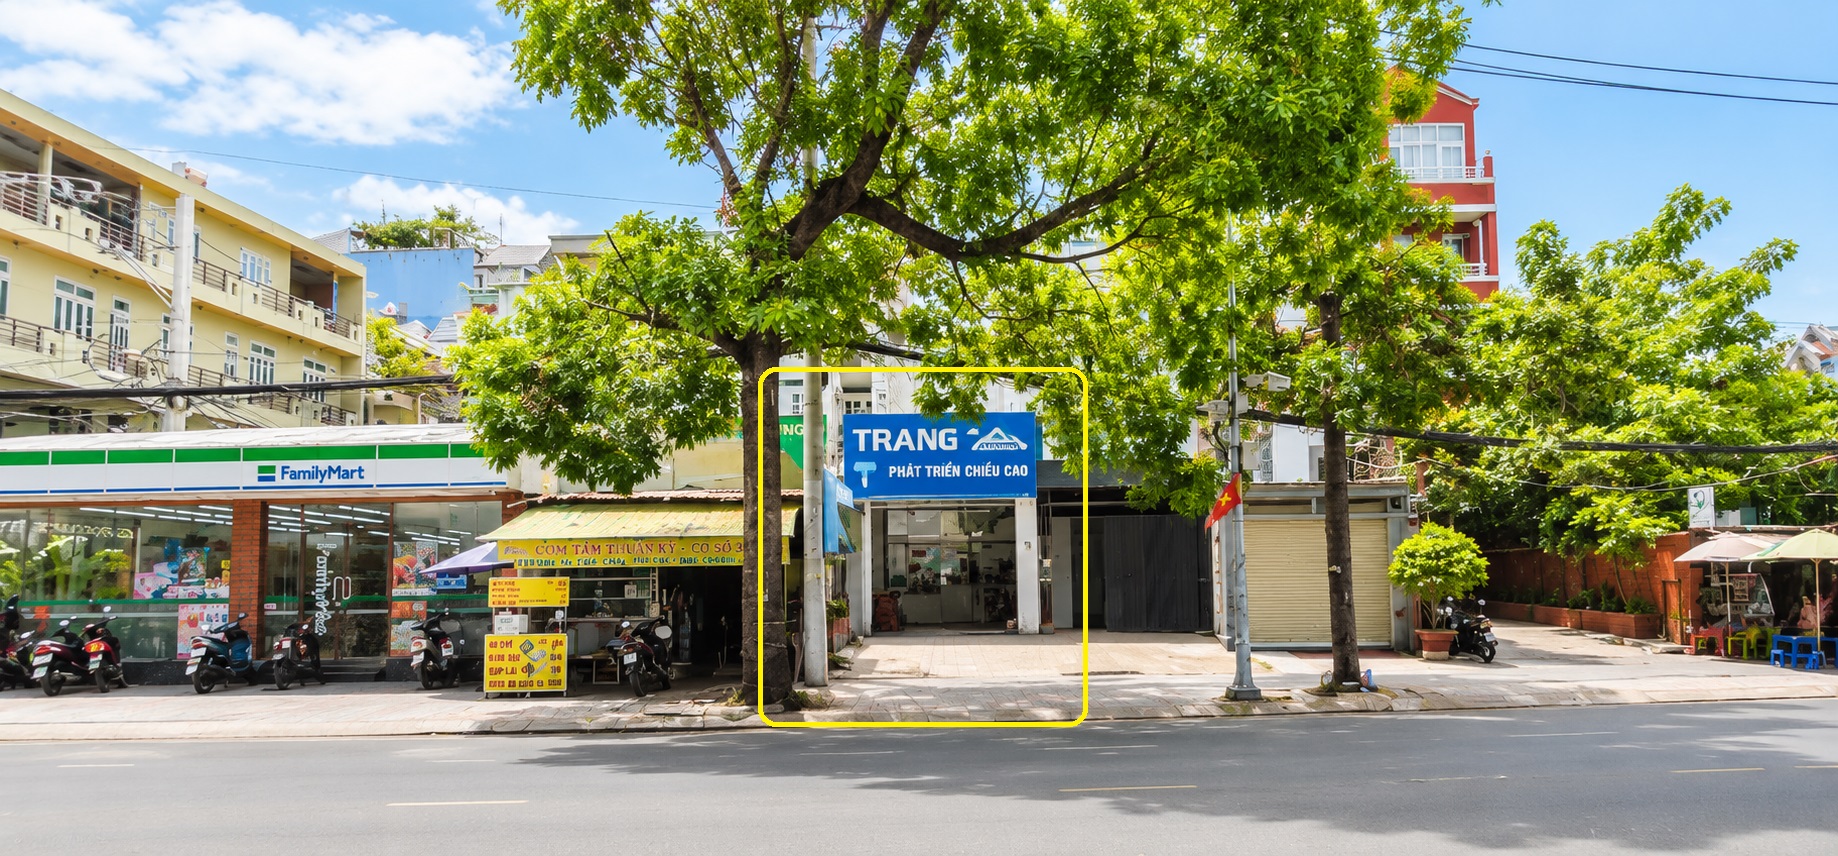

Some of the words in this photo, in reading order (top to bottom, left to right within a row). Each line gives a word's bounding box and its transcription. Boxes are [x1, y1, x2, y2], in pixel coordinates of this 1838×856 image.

[852, 428, 958, 452] TRANG
[281, 465, 364, 484] FamilyMart
[1004, 465, 1029, 477] CAO
